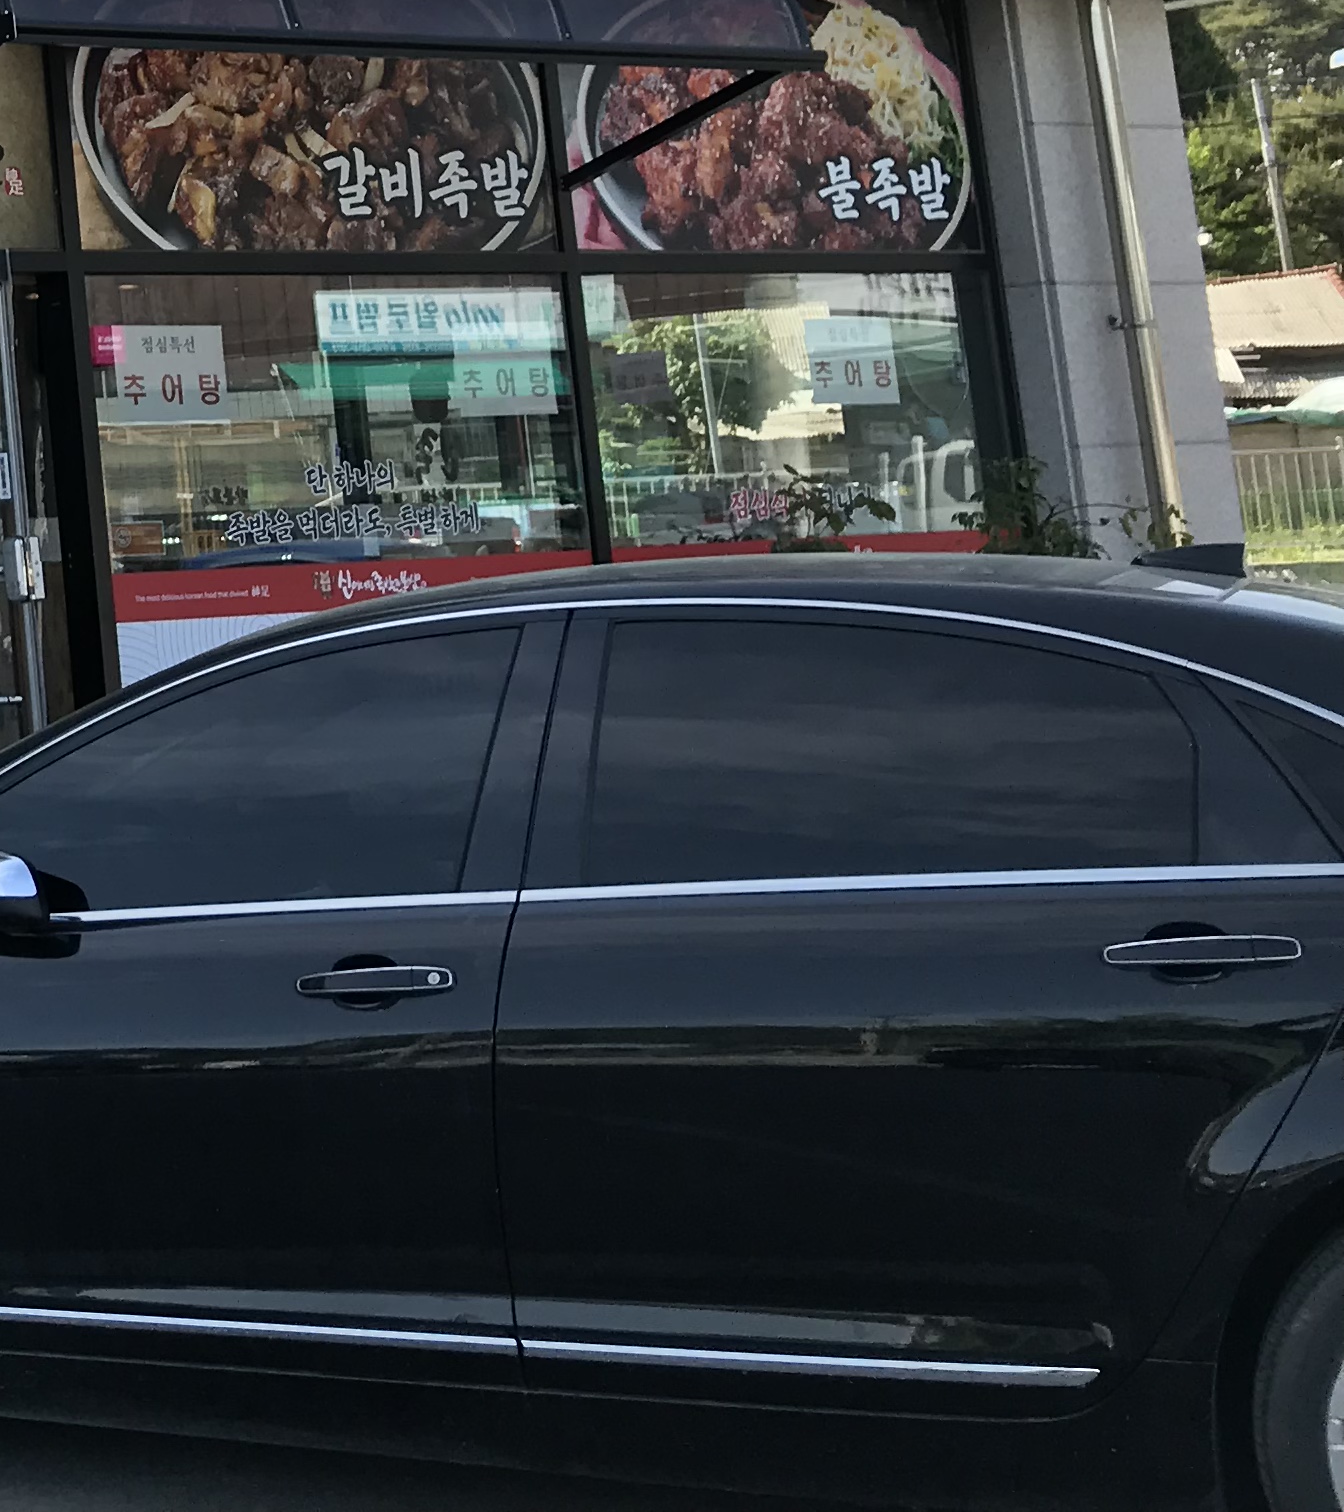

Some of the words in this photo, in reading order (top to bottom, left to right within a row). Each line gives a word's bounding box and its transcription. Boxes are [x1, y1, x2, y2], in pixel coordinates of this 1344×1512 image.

[322, 146, 529, 219] 갈비족발
[818, 155, 951, 222] 불족발
[141, 336, 195, 354] 점심특선
[306, 463, 328, 496] 단
[333, 459, 395, 493] 하나의
[226, 511, 295, 546] 족발을
[299, 504, 392, 540] 먹더라도,
